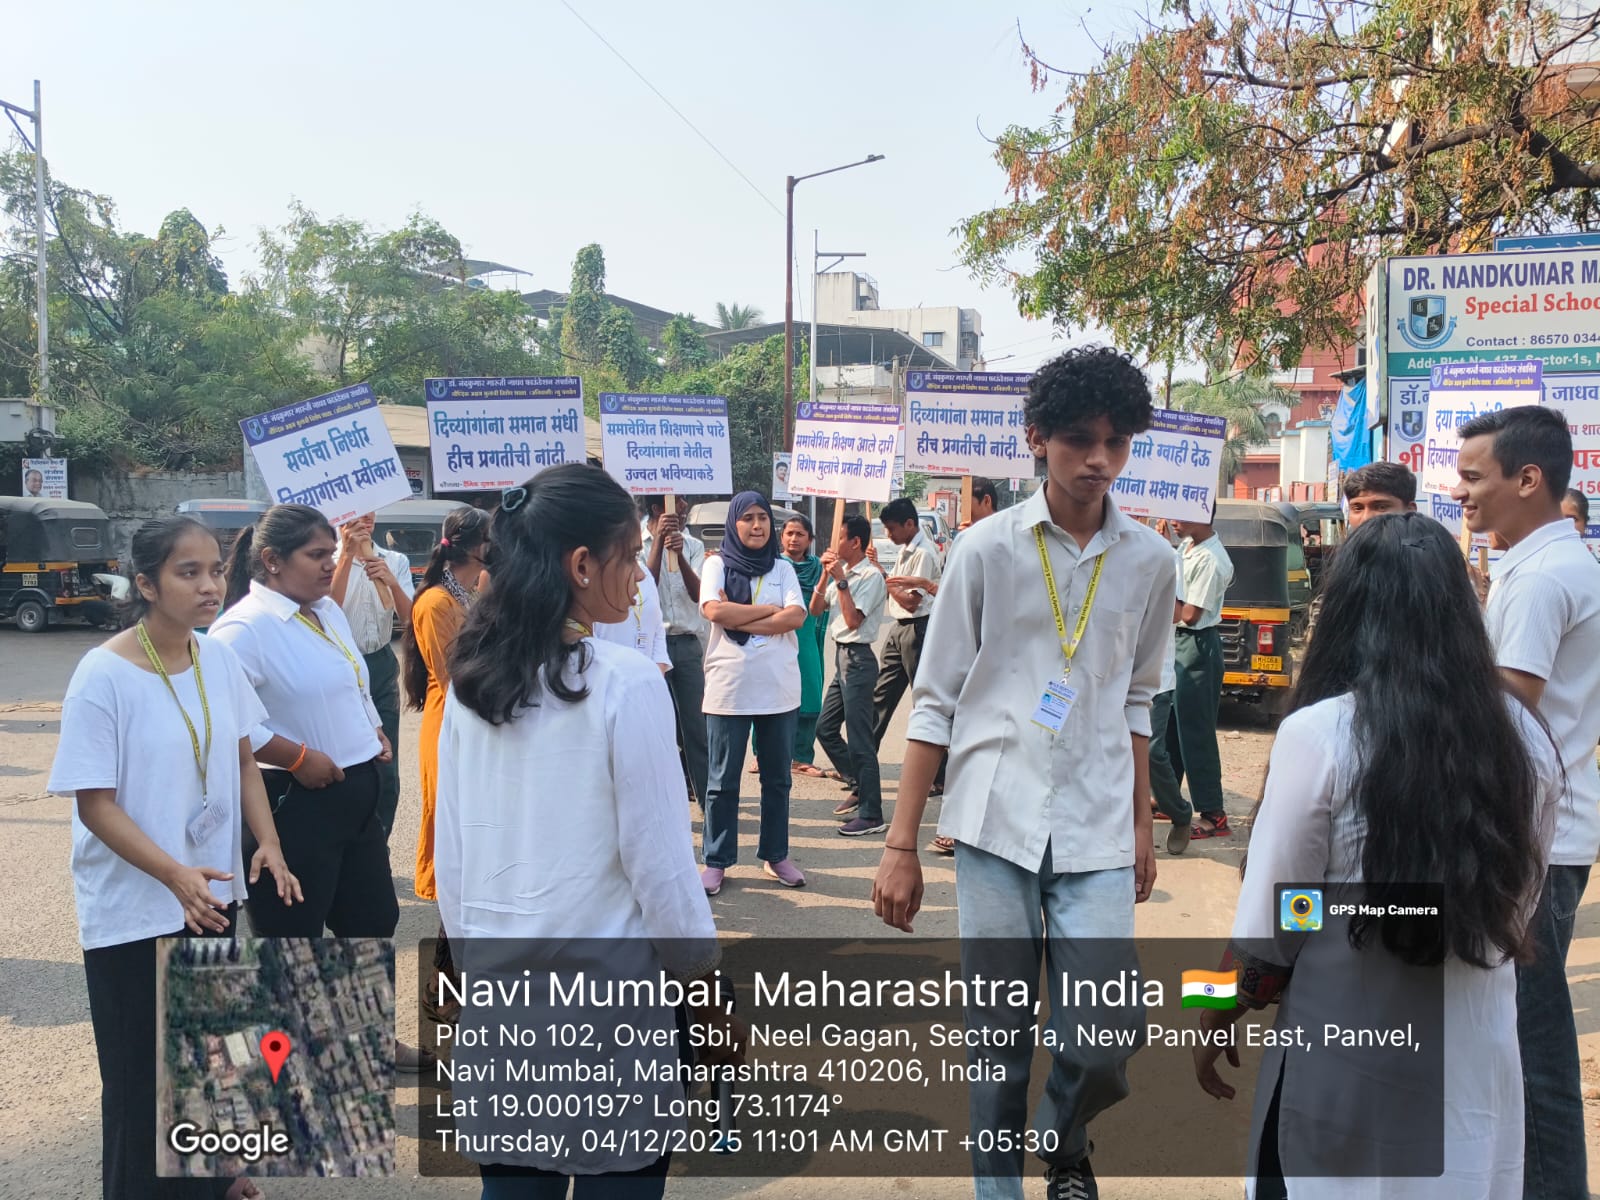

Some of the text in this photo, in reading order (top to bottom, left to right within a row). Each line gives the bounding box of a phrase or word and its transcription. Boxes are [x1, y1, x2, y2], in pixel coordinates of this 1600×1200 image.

[1403, 259, 1600, 291] DR. NANDKUMAR M
[1465, 292, 1600, 320] Special Schoo
[1466, 336, 1518, 347] Contact
[1530, 334, 1569, 345] 86570
[1552, 385, 1600, 401] जाधव
[434, 408, 579, 438] दिव्यांगांना समान संधी
[910, 400, 968, 425] दिव्यांगांना
[970, 409, 1004, 427] समान
[1436, 410, 1453, 432] दया
[328, 421, 373, 457] निर्धार
[606, 418, 657, 436] समावेशित
[660, 418, 705, 437] शिक्षणाचे
[627, 441, 712, 459] दिव्यांगांना नेतील
[832, 432, 856, 451] शिक्षण
[857, 433, 877, 453] आले
[917, 431, 939, 456] हीच
[942, 433, 987, 457] प्रगतीची
[1191, 440, 1212, 467] देऊ
[447, 444, 475, 473] हीच
[478, 442, 530, 468] प्रगतीची
[797, 454, 816, 473] विशेष
[841, 457, 863, 477] प्रगती
[864, 460, 887, 479] झाली
[352, 458, 399, 490] स्वीकार
[625, 464, 714, 481] उज्वल भविष्याकडे
[1149, 480, 1179, 500] सक्षम
[1182, 484, 1210, 513] बनवू
